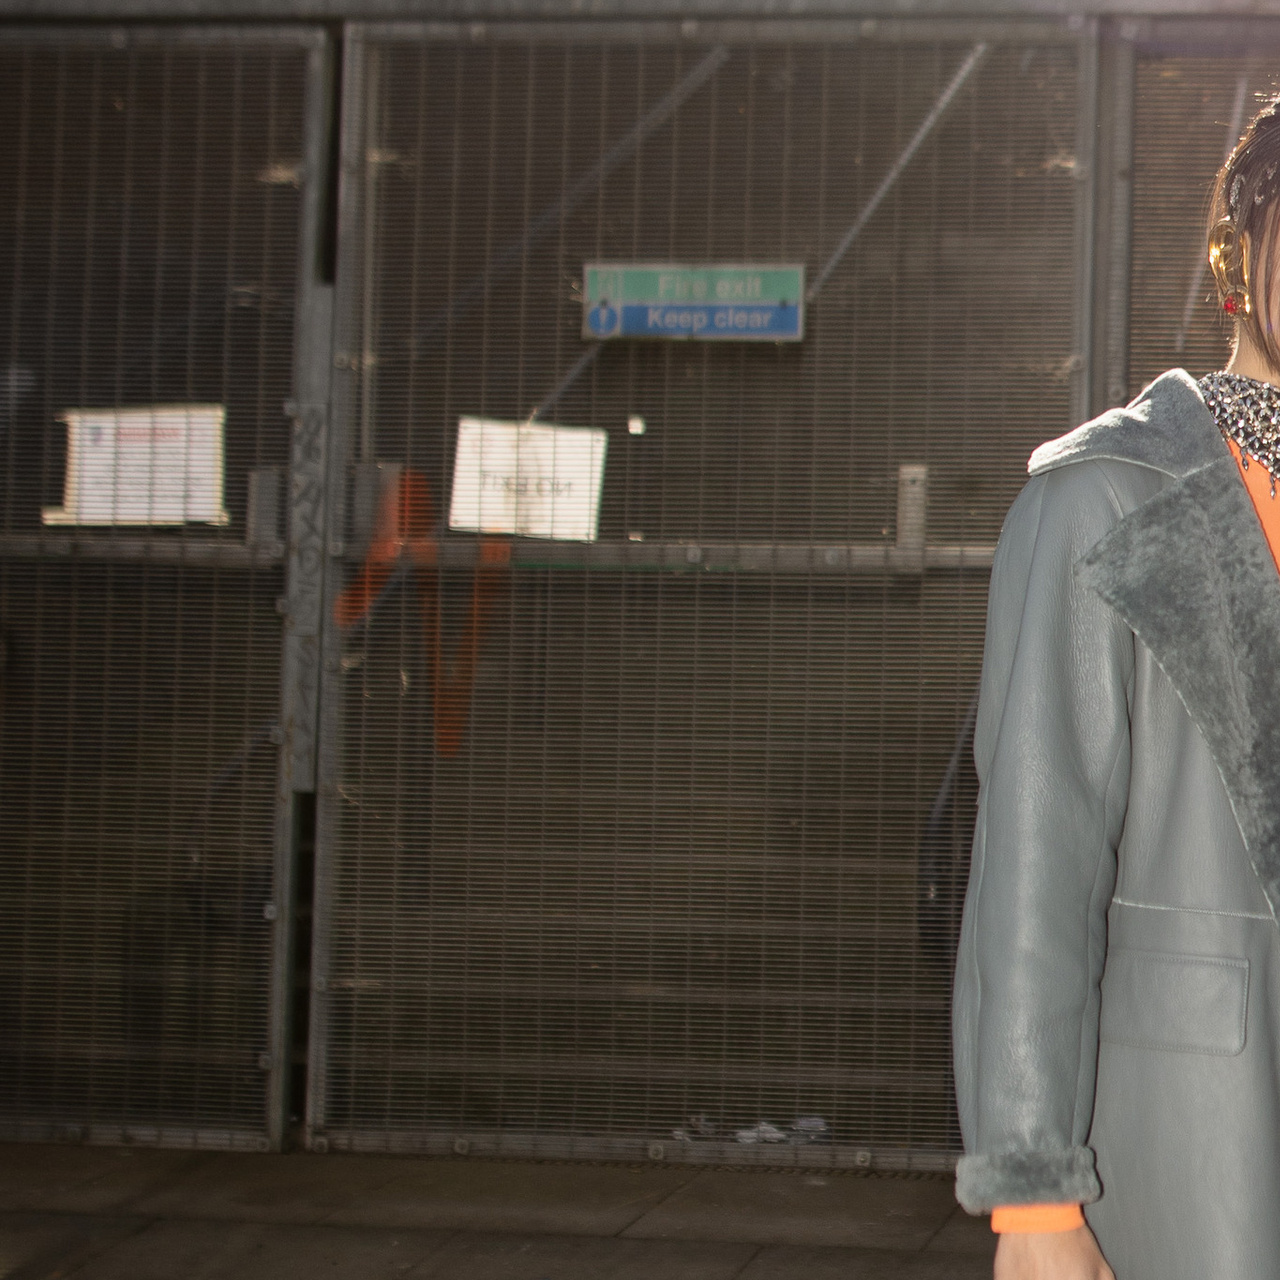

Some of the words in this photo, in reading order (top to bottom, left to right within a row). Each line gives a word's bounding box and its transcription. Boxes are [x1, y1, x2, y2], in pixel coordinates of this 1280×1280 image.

[658, 277, 707, 298] Fire
[715, 276, 761, 298] exit
[647, 308, 707, 332] Keep
[714, 308, 772, 328] clear
